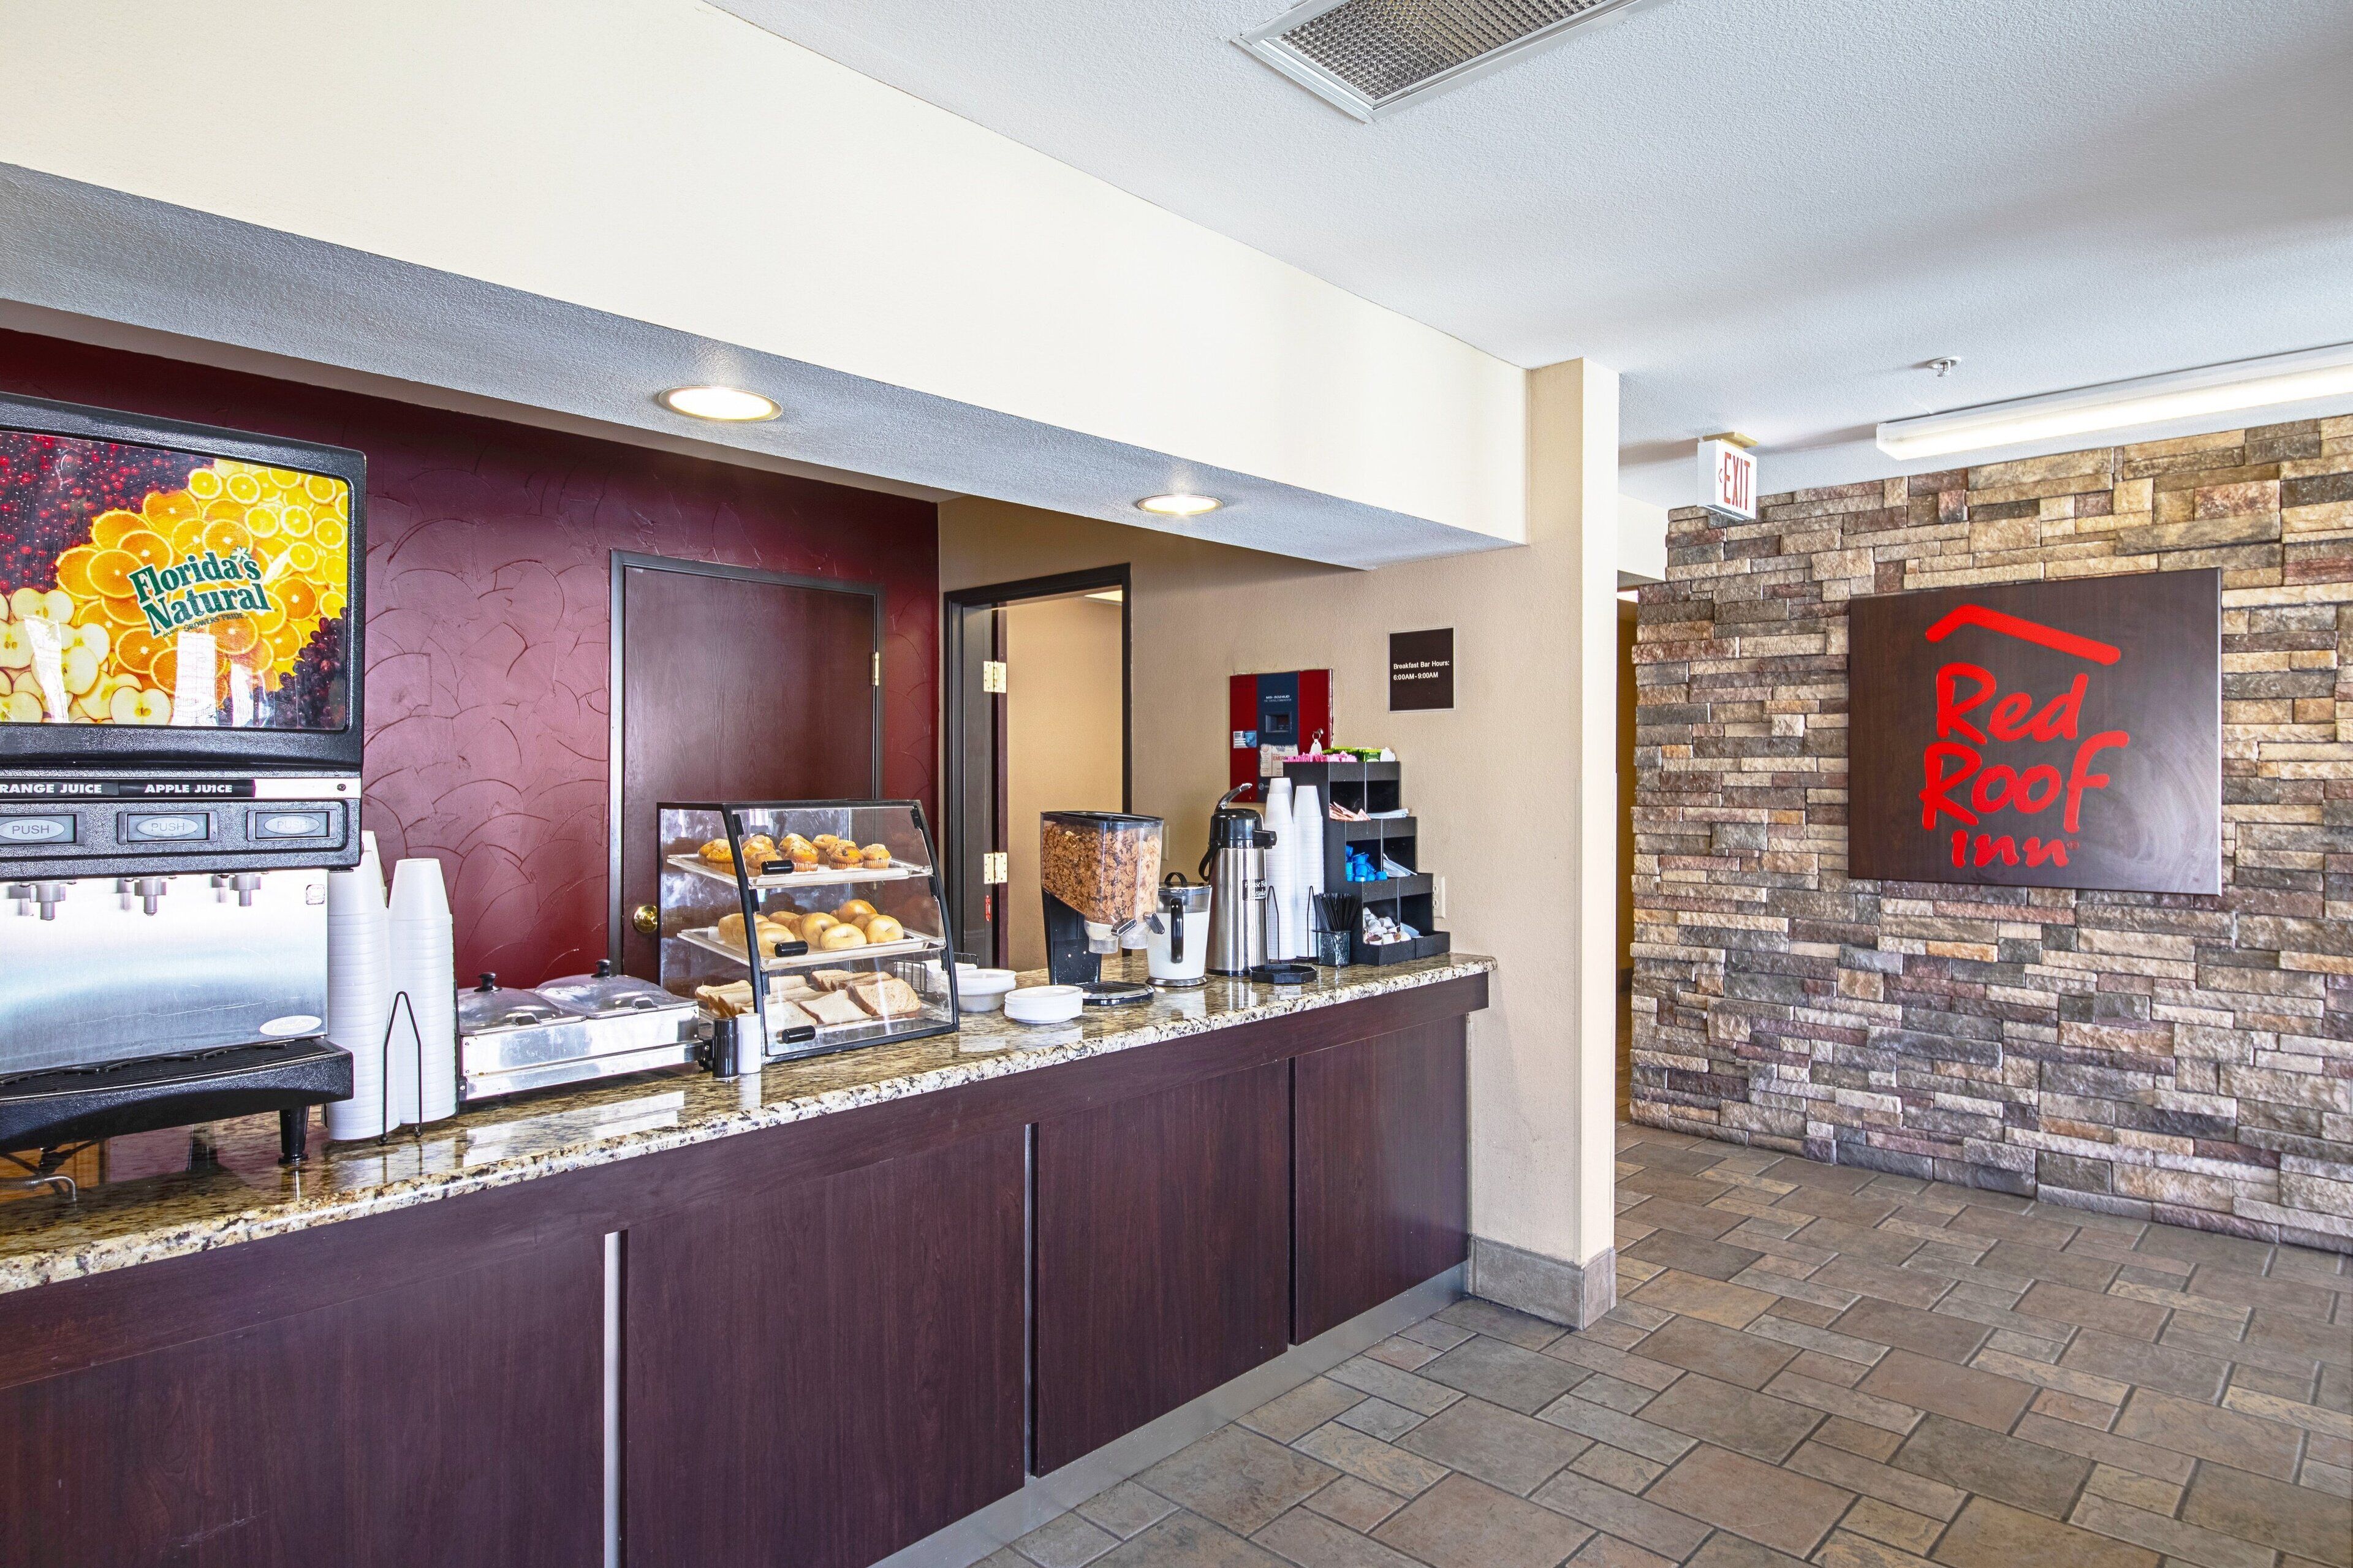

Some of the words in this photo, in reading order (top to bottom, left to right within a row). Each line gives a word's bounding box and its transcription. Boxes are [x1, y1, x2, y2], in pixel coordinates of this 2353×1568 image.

[1724, 452, 1750, 510] EXIT
[129, 550, 262, 603] Florida's
[142, 583, 271, 636] Natural
[1936, 662, 2088, 745] Red
[59, 784, 102, 793] JUICE
[144, 784, 190, 793] APPLE
[194, 784, 233, 793] JUICE
[1919, 730, 2130, 833] Roof
[12, 825, 50, 835] PUSH
[151, 822, 185, 831] PUSH
[277, 819, 307, 830] PUSH
